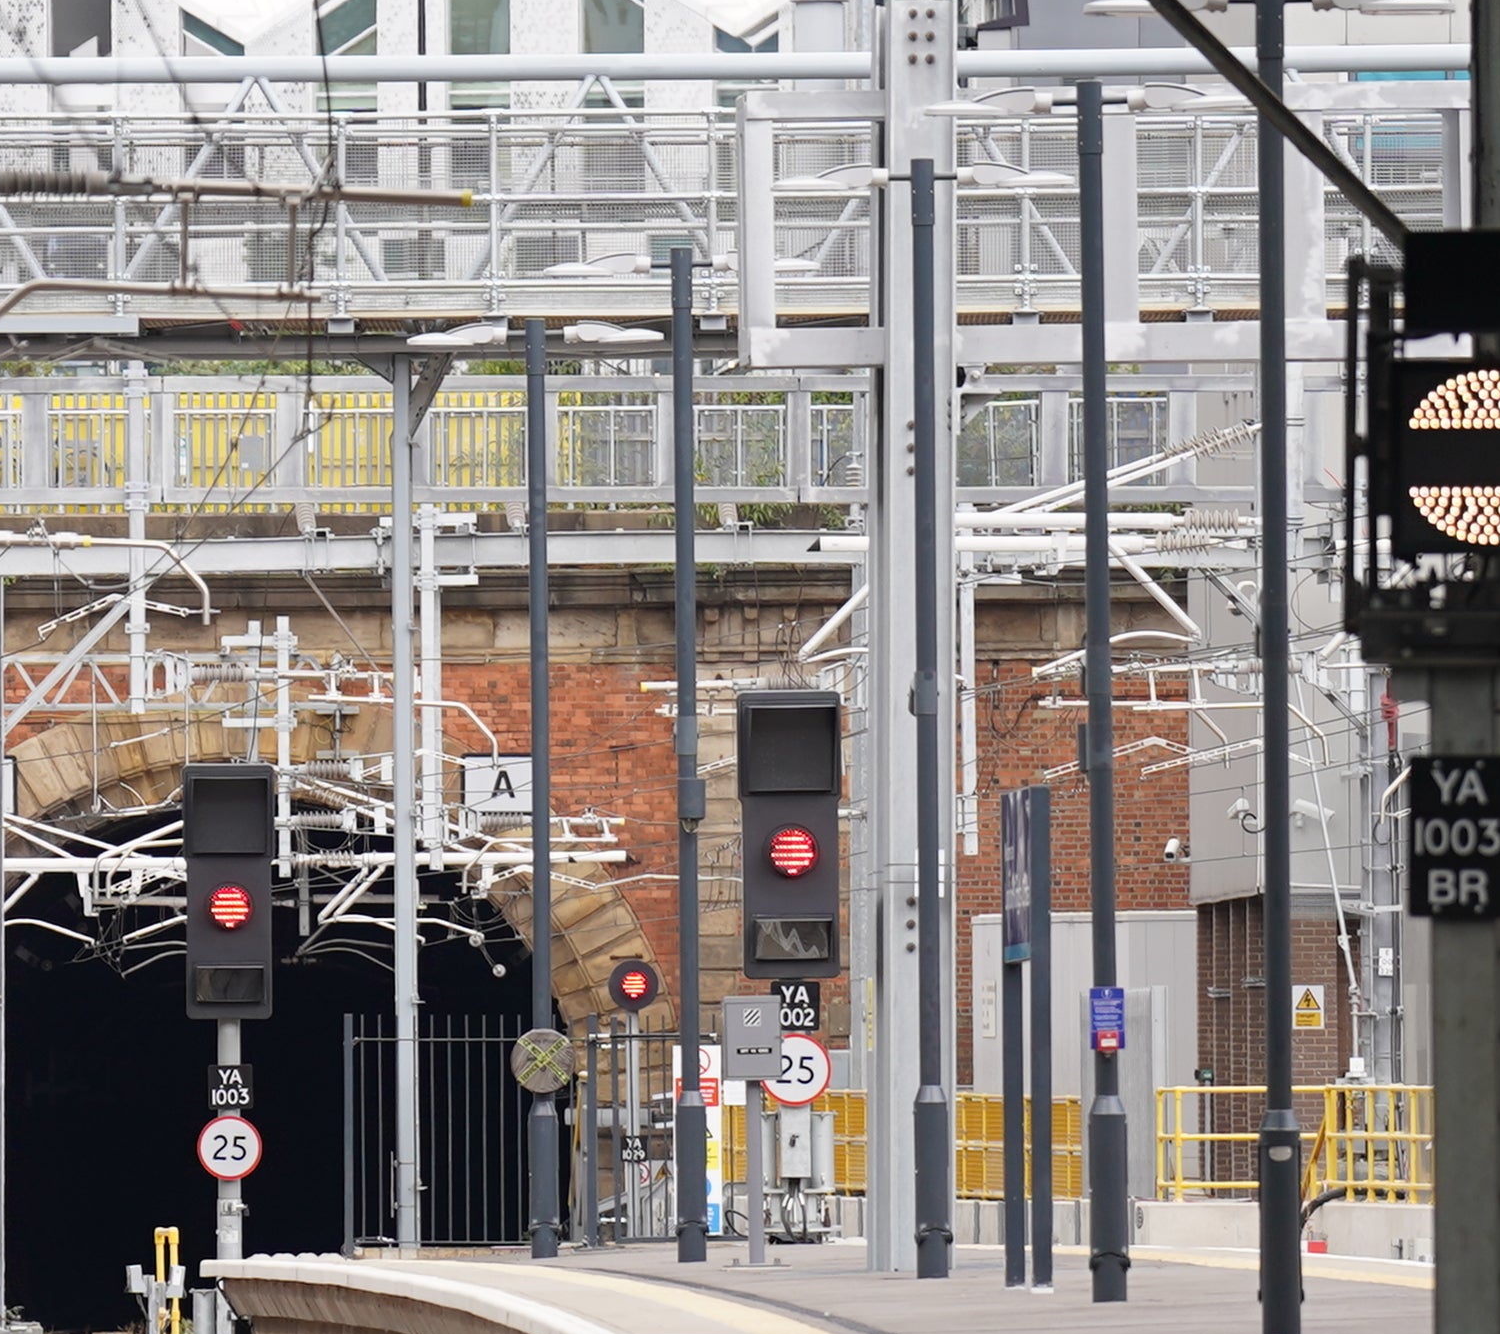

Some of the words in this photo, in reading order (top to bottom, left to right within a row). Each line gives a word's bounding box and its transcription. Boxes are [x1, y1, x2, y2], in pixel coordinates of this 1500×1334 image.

[491, 770, 515, 799] A
[1430, 768, 1488, 805] YA
[1428, 869, 1489, 905] BR
[781, 985, 810, 1004] YA
[780, 1007, 815, 1027] 002
[218, 1069, 243, 1085] YA
[776, 1055, 814, 1085] 25
[211, 1087, 250, 1105] 1003
[212, 1134, 247, 1161] 25
[626, 1137, 641, 1148] YA
